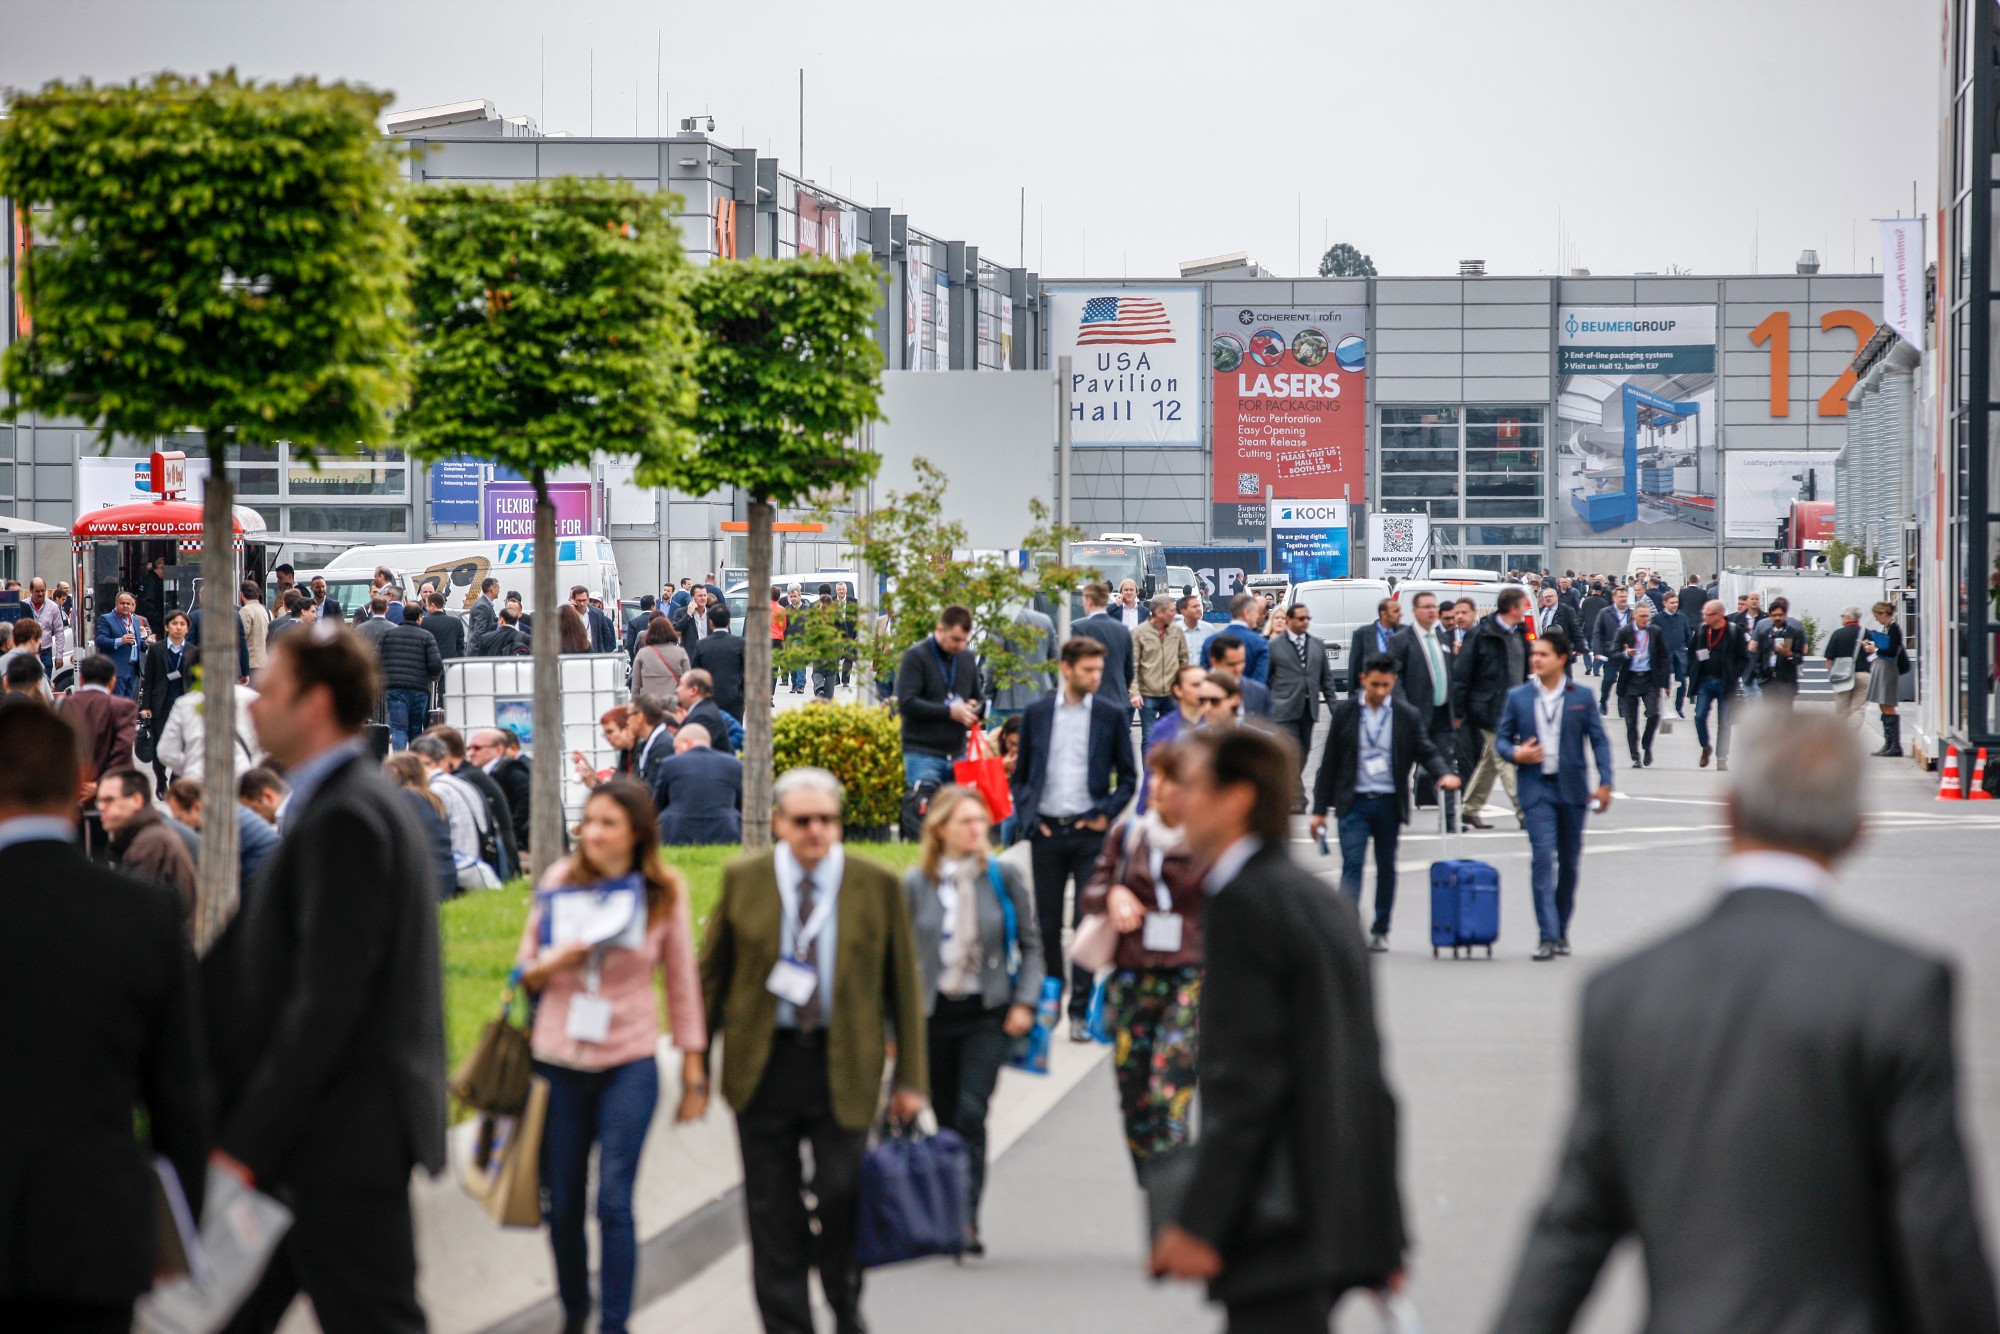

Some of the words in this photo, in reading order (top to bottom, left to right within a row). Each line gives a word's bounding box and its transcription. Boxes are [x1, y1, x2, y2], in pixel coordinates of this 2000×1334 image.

[1319, 311, 1342, 321] rofin
[1581, 320, 1676, 332] BEUMERGROUP
[1097, 351, 1151, 371] USA
[1609, 352, 1644, 361] packaging
[1645, 352, 1674, 360] systems
[1570, 362, 1586, 370] Visit
[1599, 362, 1613, 370] Hall
[1613, 363, 1624, 371] 12,
[1625, 362, 1645, 370] booth
[1646, 362, 1659, 370] E37
[1749, 309, 1880, 417] 12
[1072, 373, 1178, 393] Pavilion
[1238, 373, 1341, 398] LASERS
[1070, 400, 1132, 421] Hall
[1152, 400, 1182, 421] 12
[1238, 400, 1262, 411] FOR
[1265, 400, 1341, 412] PACKAGING
[1238, 413, 1266, 423] Micro
[1269, 412, 1322, 423] Perforation
[1238, 424, 1261, 436] Easy
[1263, 424, 1306, 438] Opening
[1238, 436, 1267, 447] Steam
[1270, 436, 1307, 447] Release
[1237, 448, 1272, 460] Cutting
[1280, 452, 1306, 462] PLEASE
[1307, 450, 1325, 459] VISIT
[1326, 448, 1337, 456] US
[1295, 459, 1313, 468] HALL
[1743, 459, 1769, 467] Leading
[1289, 464, 1315, 475] BOOTH
[134, 472, 150, 480] PM
[496, 498, 538, 514] FLEXIBL
[1237, 504, 1267, 513] Superio
[1237, 511, 1267, 520] Liability
[1296, 507, 1336, 520] KOCH
[561, 519, 582, 535] FOR
[1244, 518, 1267, 526] Perfor
[88, 522, 204, 534] www.sv-group.com
[1294, 533, 1310, 541] going
[1285, 542, 1309, 550] Together
